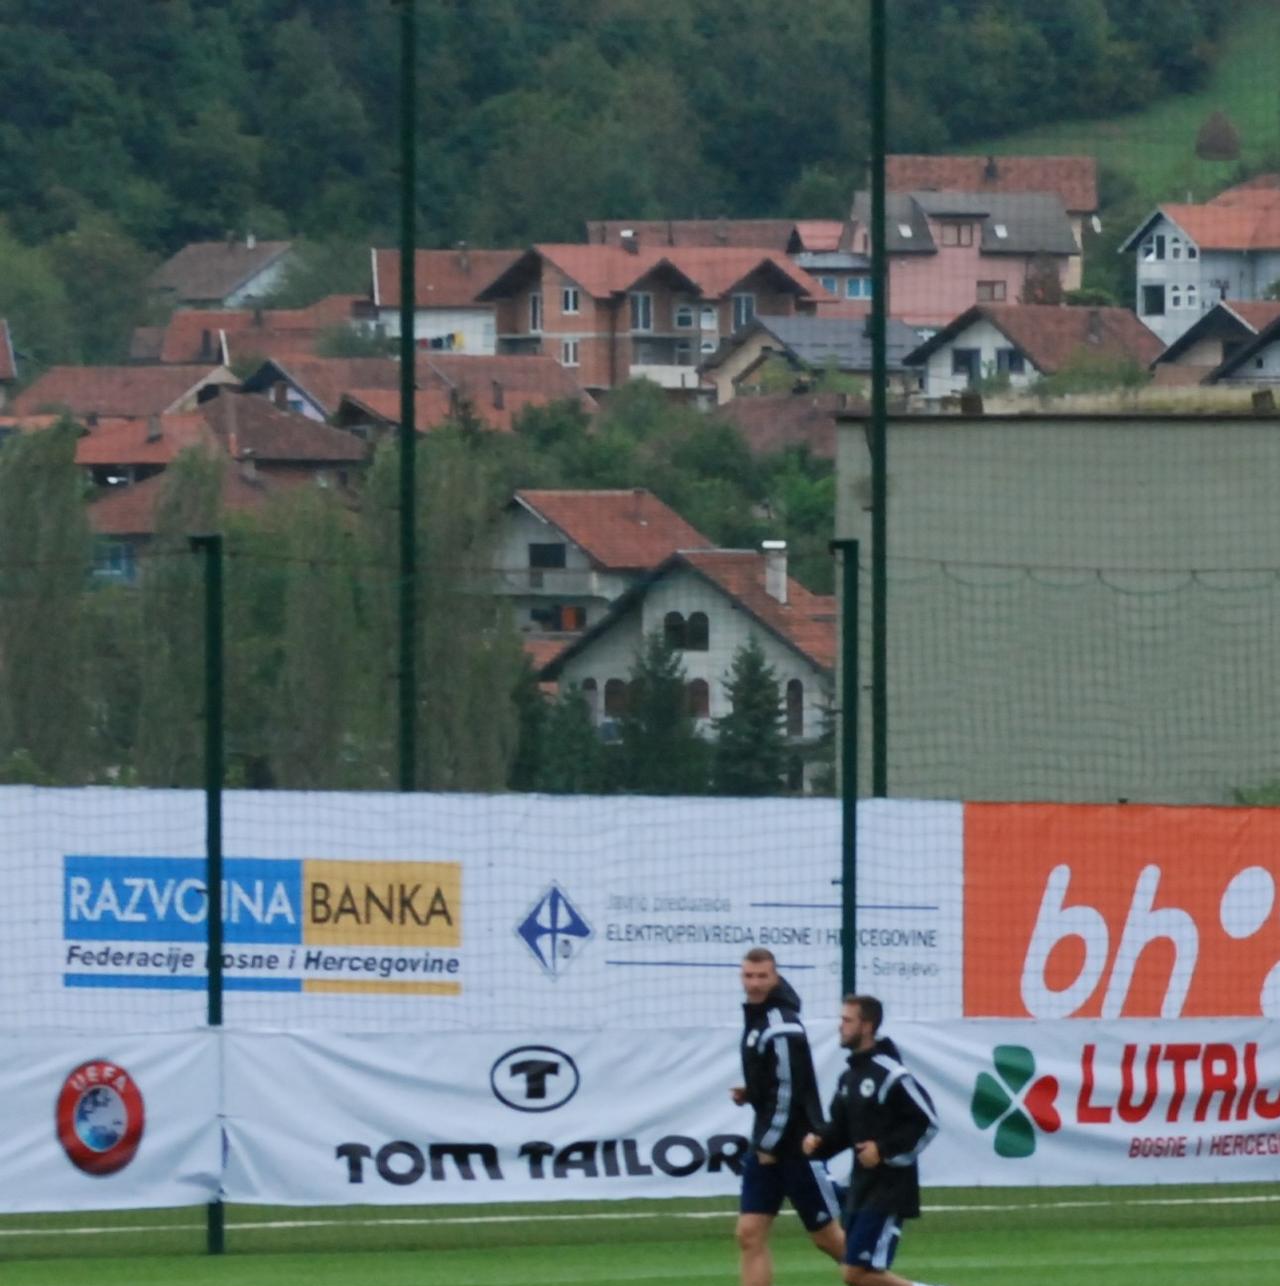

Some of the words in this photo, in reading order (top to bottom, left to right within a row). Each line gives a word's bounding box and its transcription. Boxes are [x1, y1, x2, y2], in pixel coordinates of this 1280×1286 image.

[310, 882, 453, 926] BANKA
[759, 926, 811, 946] BOSNE
[826, 929, 937, 948] HCEGOVINE
[1020, 864, 1199, 1019] bh
[67, 945, 195, 973] Federacije
[206, 951, 279, 970] osne
[287, 949, 295, 970] i
[304, 951, 459, 977] Hercegovine
[71, 1065, 127, 1093] UEFA
[336, 1141, 504, 1186] TOM
[518, 1134, 748, 1180] TAILOR
